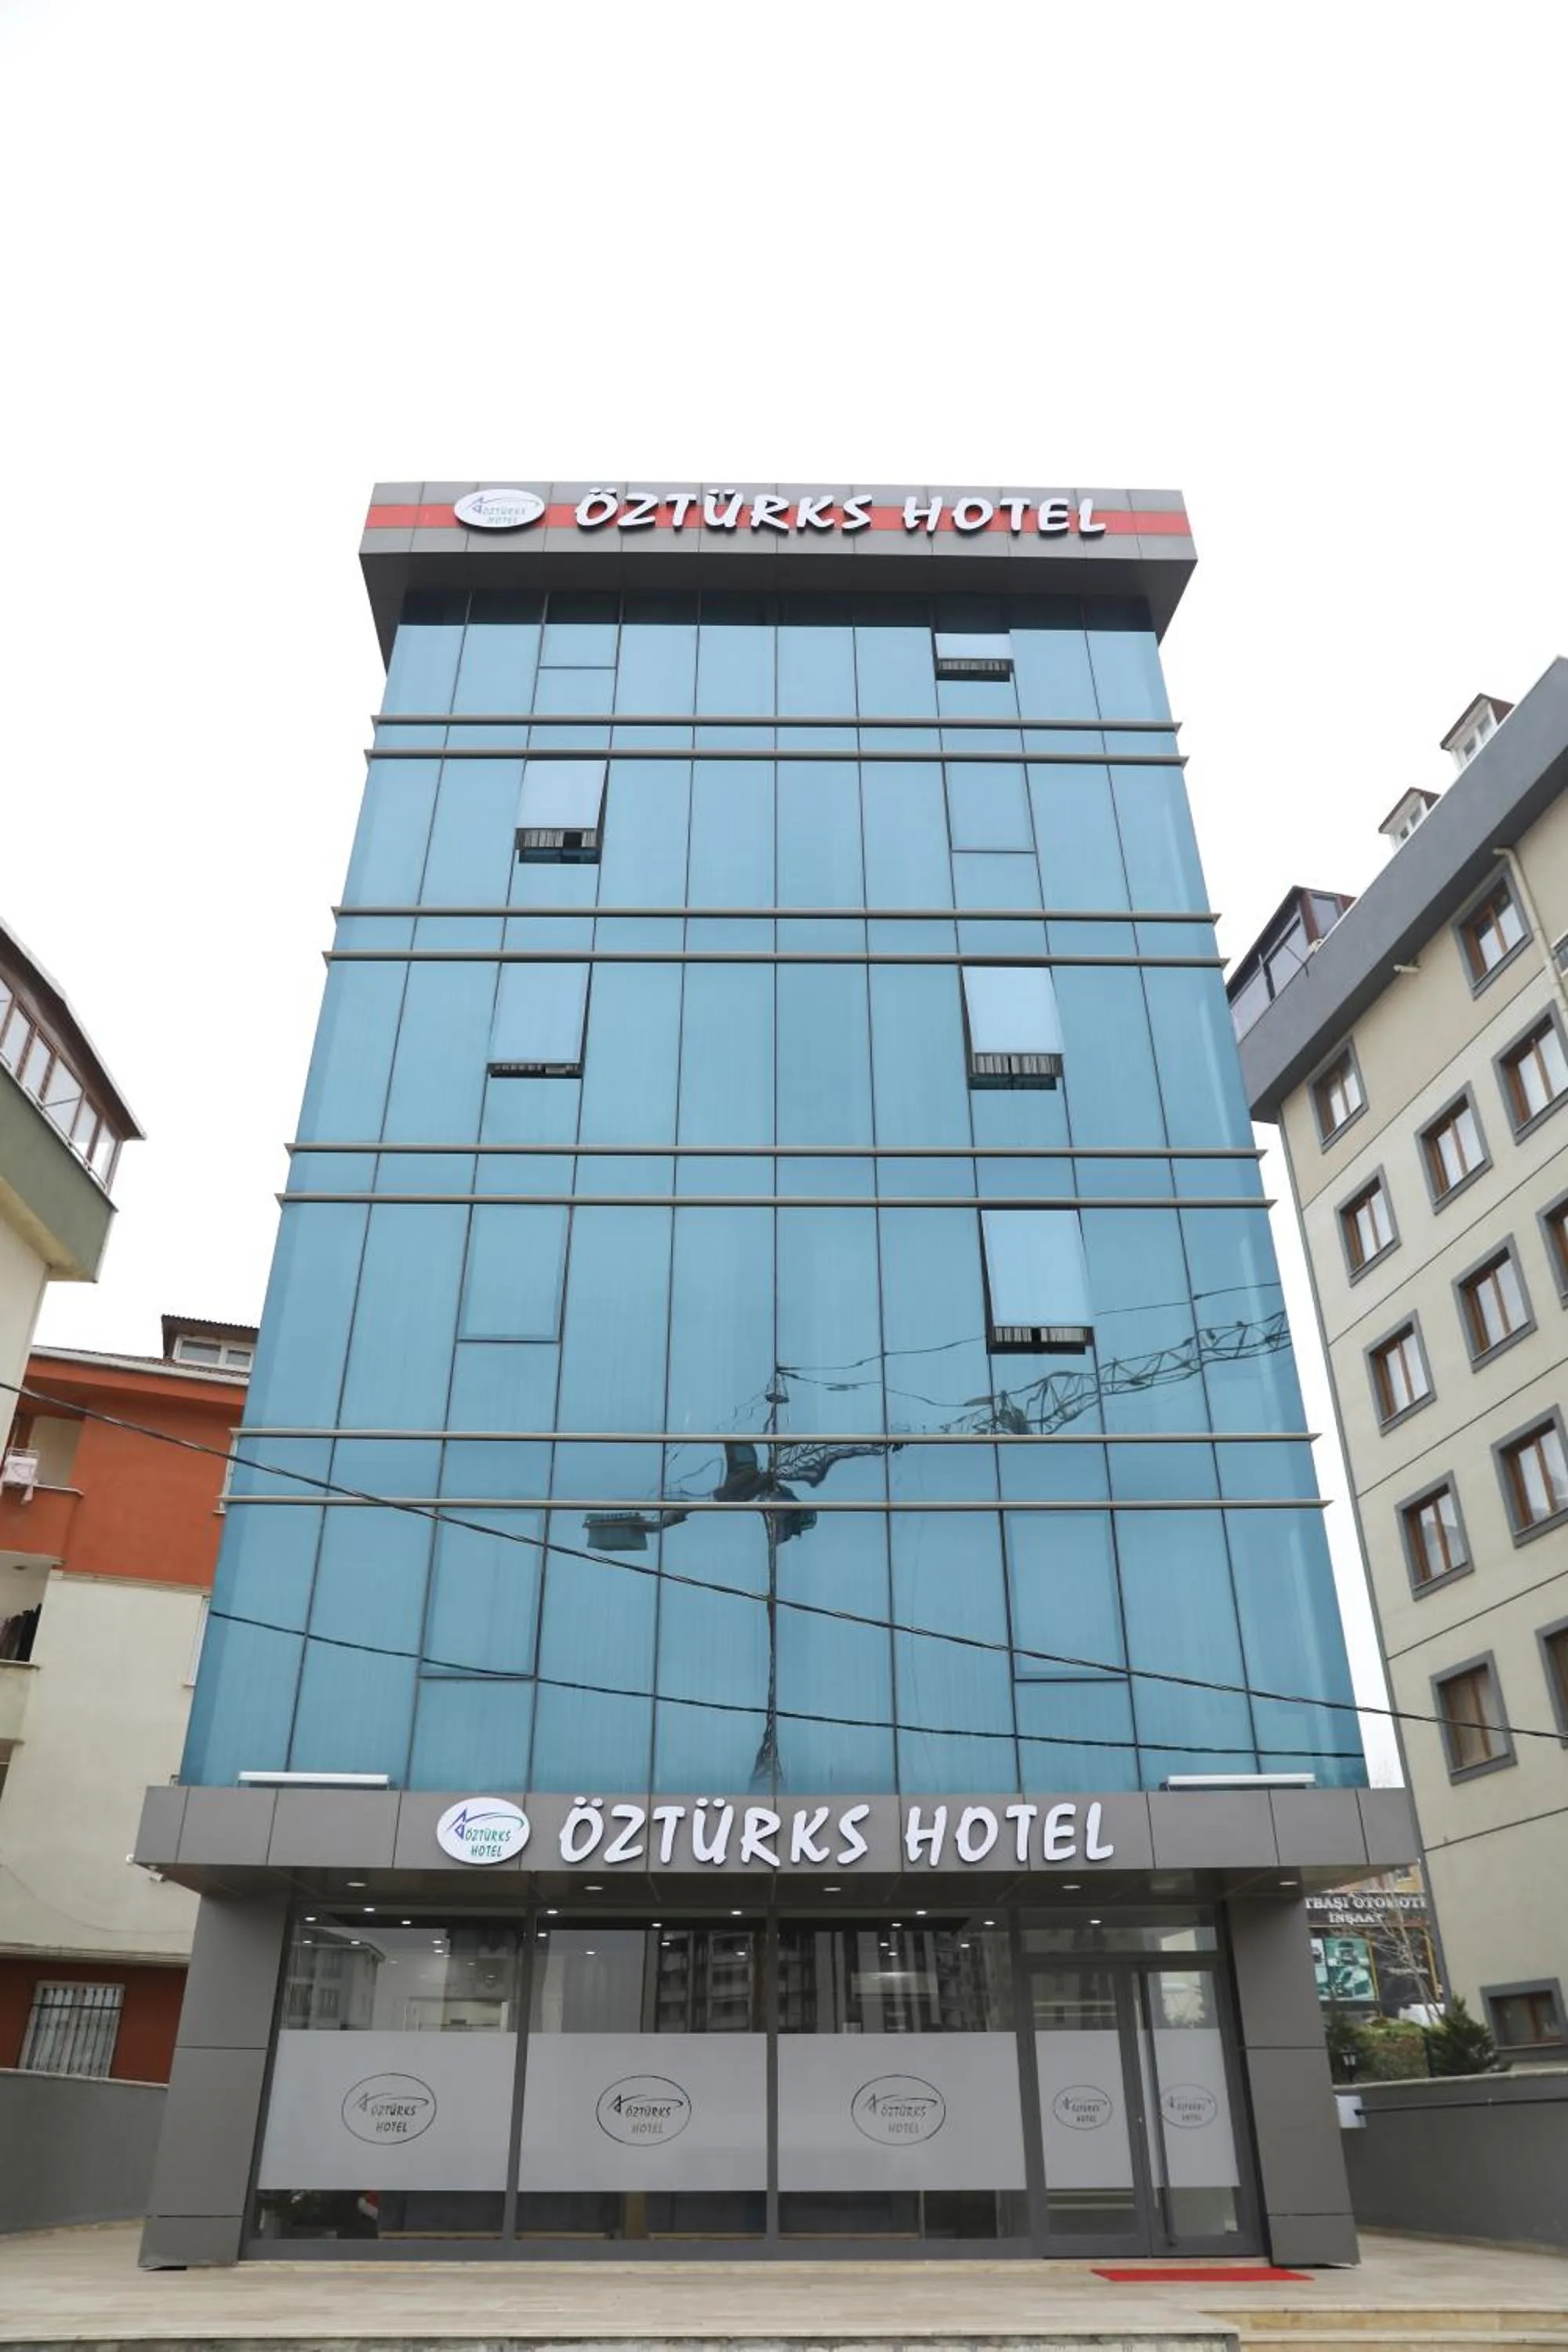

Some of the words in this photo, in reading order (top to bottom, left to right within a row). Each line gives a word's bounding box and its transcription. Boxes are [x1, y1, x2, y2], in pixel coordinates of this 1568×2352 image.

[575, 488, 873, 532] ÖZTÜRKS
[902, 495, 1107, 535] HOTEL
[465, 1826, 511, 1842] ÖZTÜRKS
[559, 1796, 870, 1867] ÖZTÜRKS
[905, 1802, 1114, 1867] HOTEL
[470, 1844, 503, 1857] HOTEL
[376, 2121, 408, 2132] HOTEL
